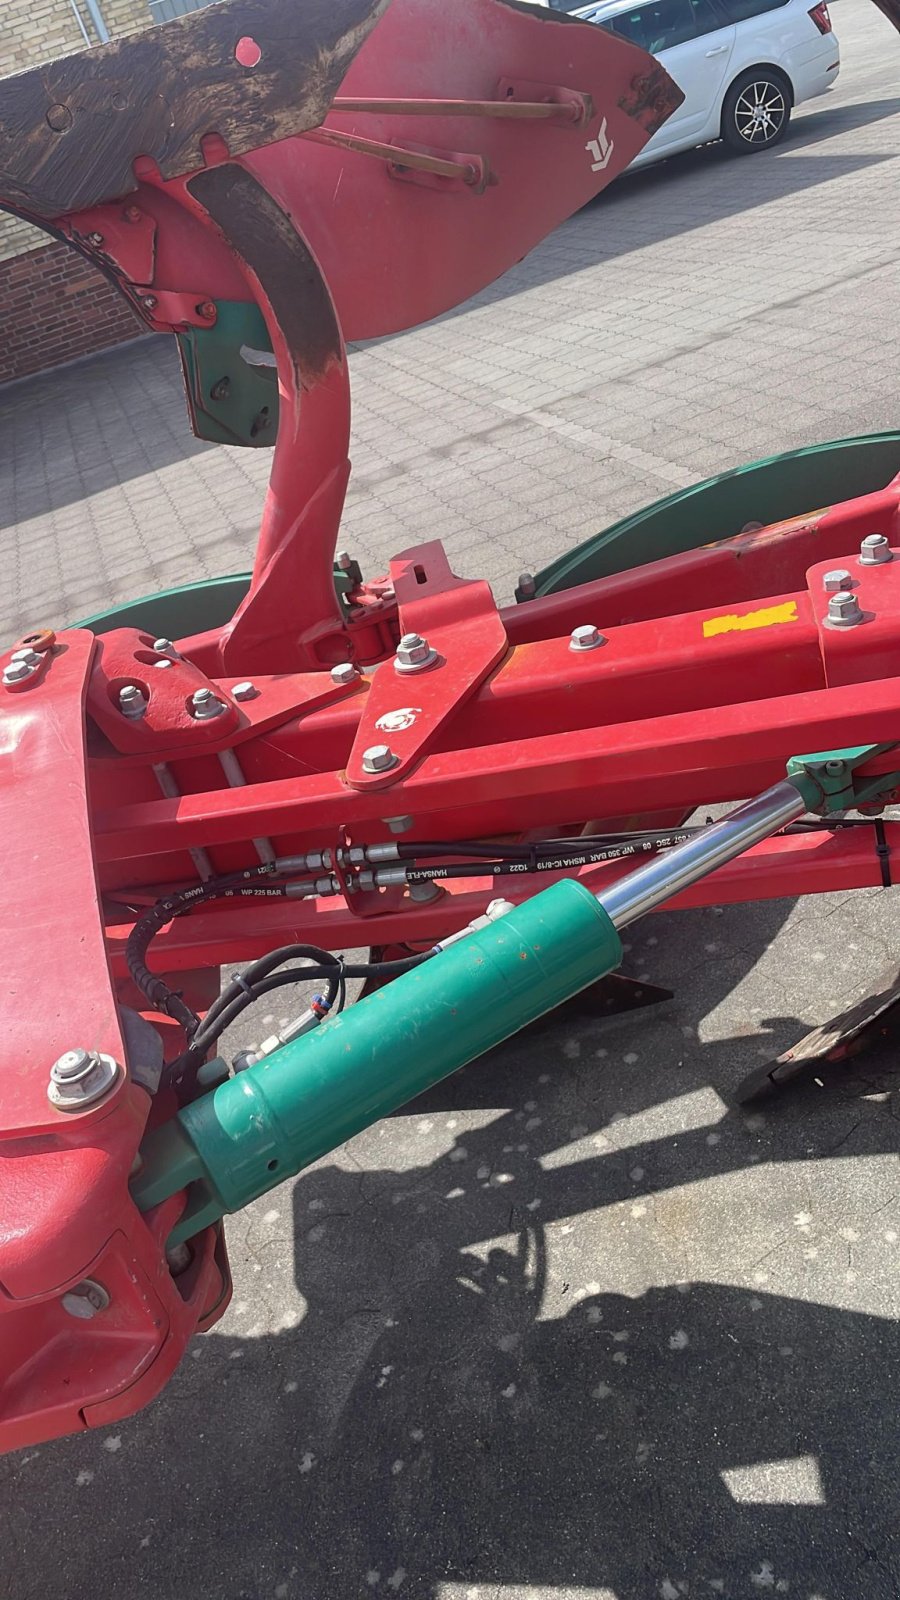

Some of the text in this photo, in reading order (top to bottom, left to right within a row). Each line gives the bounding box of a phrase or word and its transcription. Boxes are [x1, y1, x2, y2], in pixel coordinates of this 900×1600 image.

[656, 838, 671, 847] 2SC
[607, 849, 621, 858] 350
[622, 845, 635, 855] WP
[563, 856, 586, 866] MSHA
[590, 852, 607, 862] BAR
[509, 864, 528, 872] 1Q22
[536, 859, 563, 870] IC-8/19
